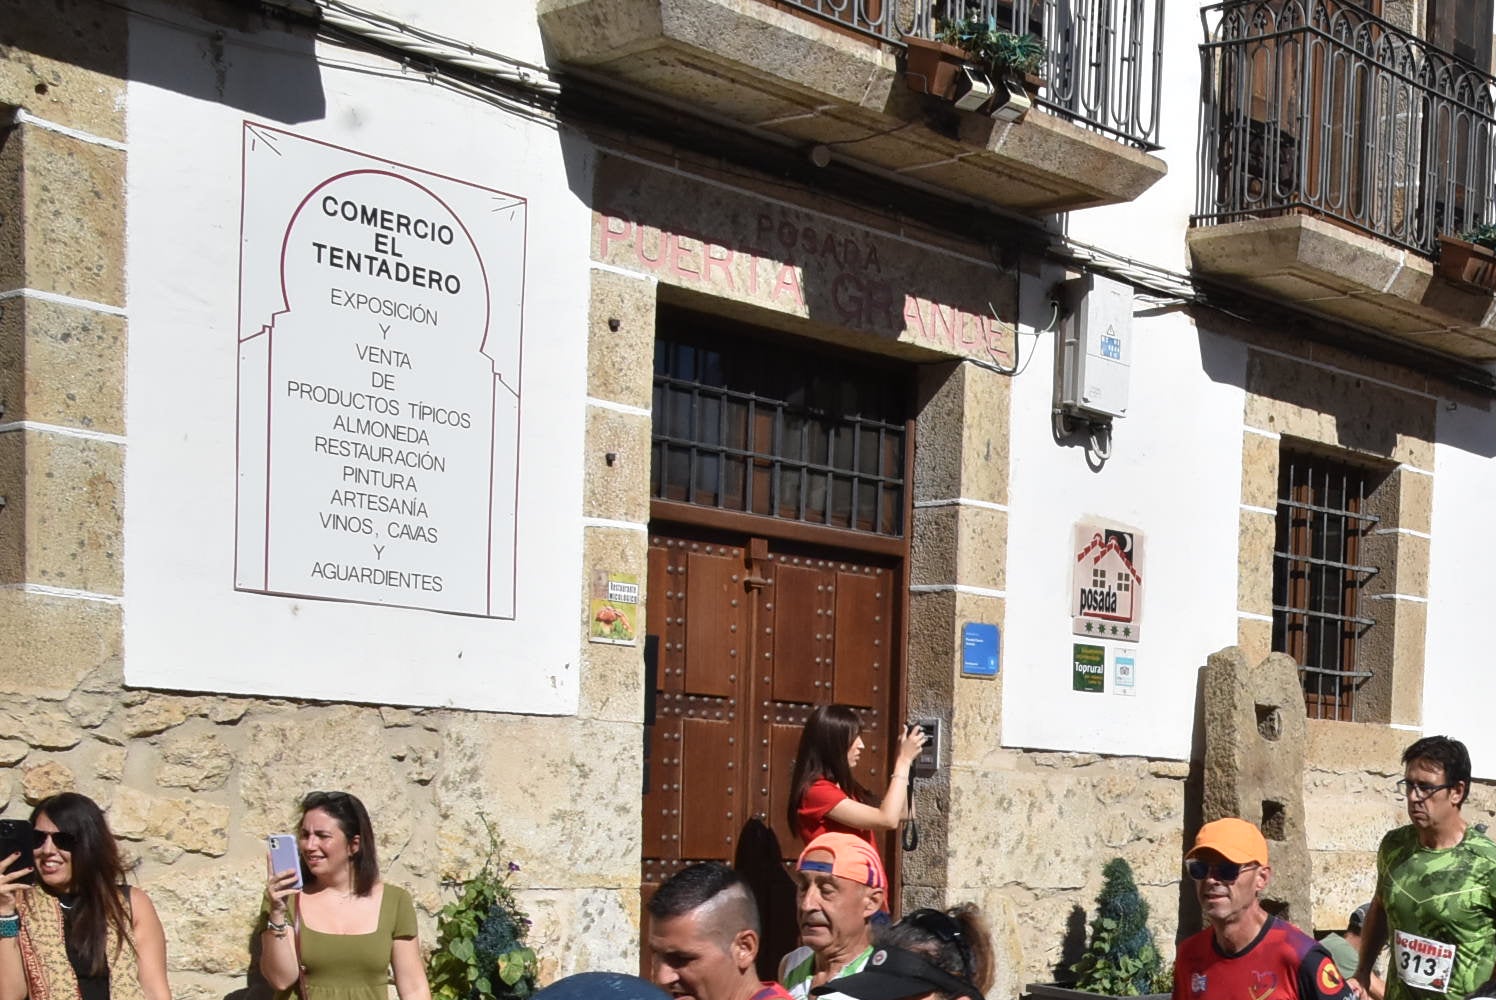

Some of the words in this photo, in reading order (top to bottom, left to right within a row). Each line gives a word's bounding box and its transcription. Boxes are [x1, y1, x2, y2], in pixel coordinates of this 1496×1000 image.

[322, 196, 454, 245] COMERCIO
[374, 233, 403, 258] EL
[755, 213, 882, 273] POSADA
[312, 242, 461, 294] TENTADERO
[600, 212, 805, 306] PUERTA
[831, 271, 1009, 359] GRANDE
[331, 288, 438, 326] EXPOSICIÓN
[379, 323, 391, 340] Y
[356, 343, 412, 370] VENTA
[371, 372, 396, 391] DE
[287, 380, 400, 416] PRODUCTOS
[408, 401, 471, 428] TÍPICOS
[333, 415, 430, 446] ALMONEDA
[315, 436, 446, 472] RESTAURACIÓN
[343, 466, 417, 492] PINTURA
[330, 489, 428, 518] ARTESANÍA
[319, 512, 379, 538] VINOS,
[387, 522, 438, 543] CAVAS
[373, 544, 385, 560] Y
[311, 561, 443, 592] AGUARDIENTES
[1080, 585, 1117, 615] posada
[1074, 661, 1104, 675] Toprural
[1400, 951, 1437, 976] 313
